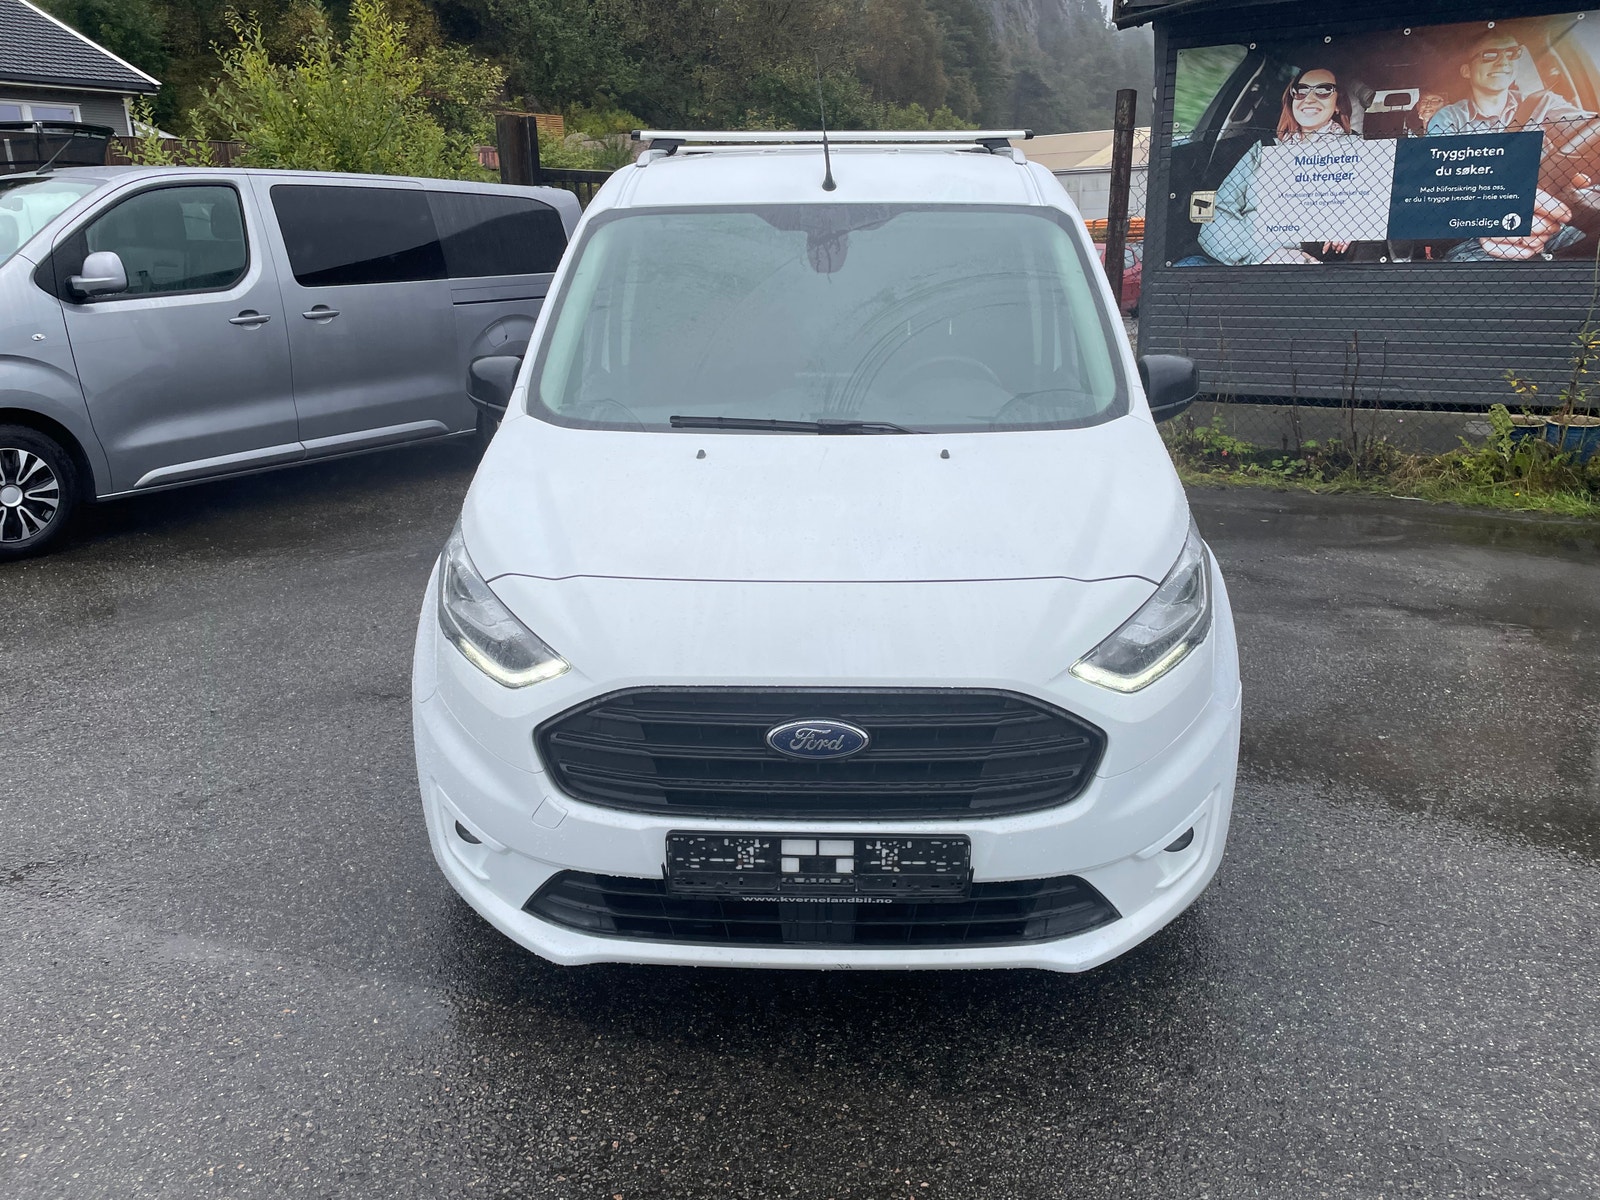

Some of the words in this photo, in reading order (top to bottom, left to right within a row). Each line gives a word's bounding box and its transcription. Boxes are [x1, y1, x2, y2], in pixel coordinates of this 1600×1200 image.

[1430, 147, 1505, 161] Tryggheten
[1294, 154, 1359, 166] Muligheten
[1435, 166, 1452, 176] du
[1455, 164, 1494, 175] søker.
[1295, 173, 1309, 182] du
[1312, 172, 1355, 182] trenger.
[1266, 224, 1300, 232] Nordea
[1449, 218, 1500, 229] Gjensidige
[790, 727, 845, 751] Ford
[742, 896, 893, 904] www.kvernelandbil.no
